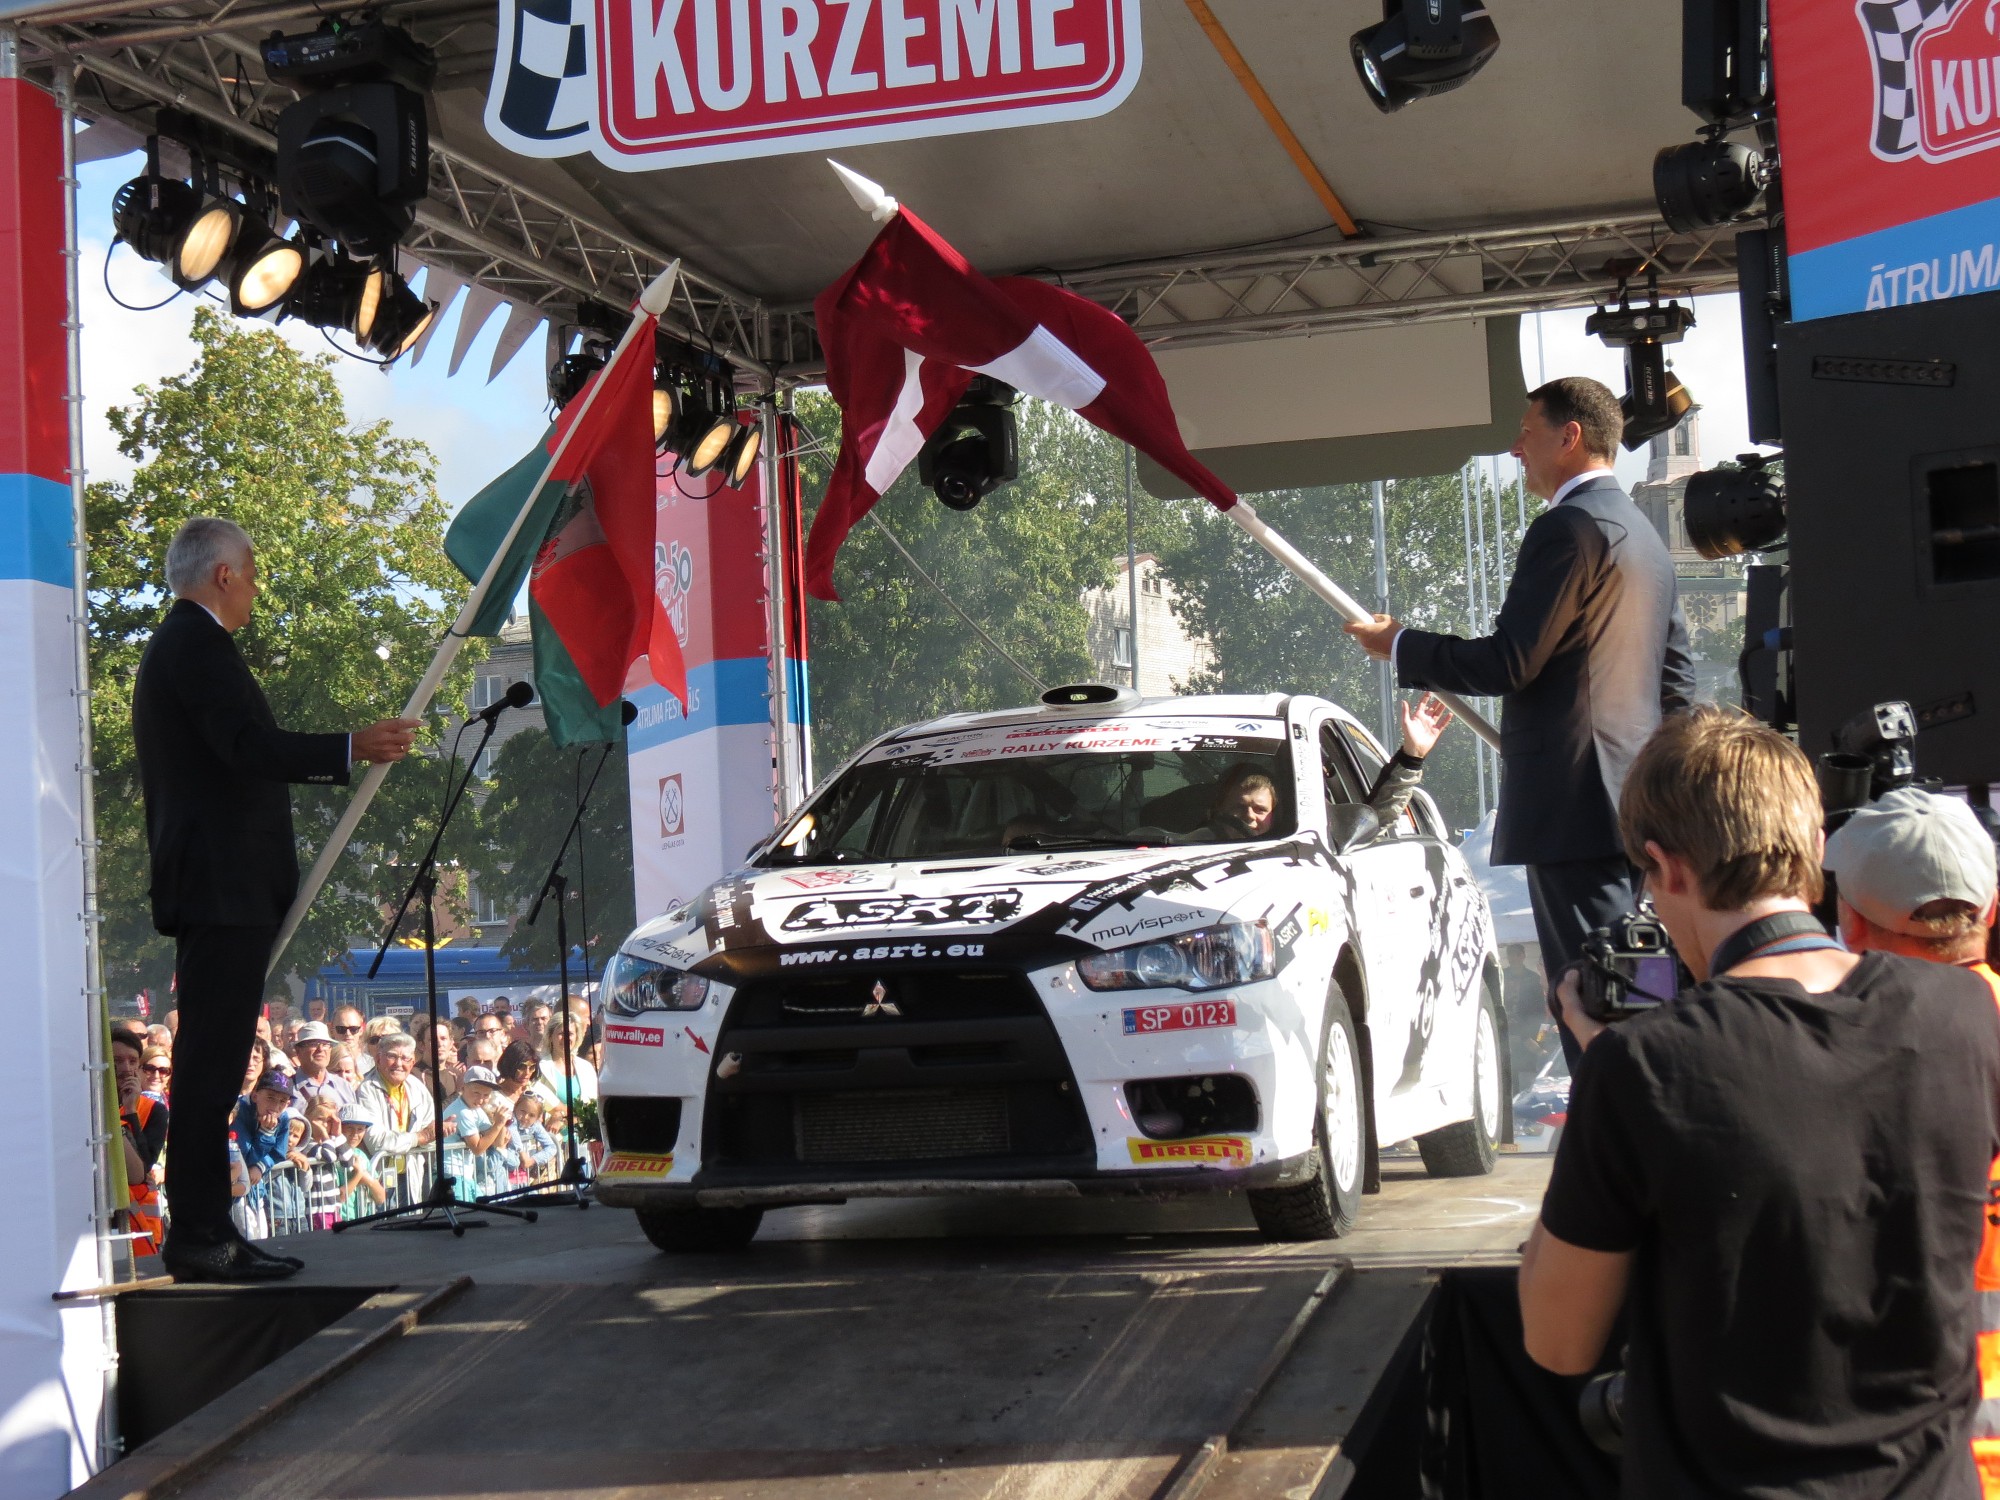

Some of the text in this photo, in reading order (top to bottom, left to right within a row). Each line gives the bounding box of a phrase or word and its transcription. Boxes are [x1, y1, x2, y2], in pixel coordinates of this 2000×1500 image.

[632, 0, 1086, 120] KURZEME
[1001, 743, 1059, 755] RALLY
[1065, 739, 1162, 750] KURZEME
[1276, 920, 1298, 948] ASRT
[780, 943, 984, 966] www.asrt.eu
[1142, 1003, 1230, 1031] SP 0123
[607, 1029, 661, 1044] www.rally.ee
[1138, 1138, 1244, 1160] PIRELLI
[603, 1155, 673, 1173] PIRELLI
